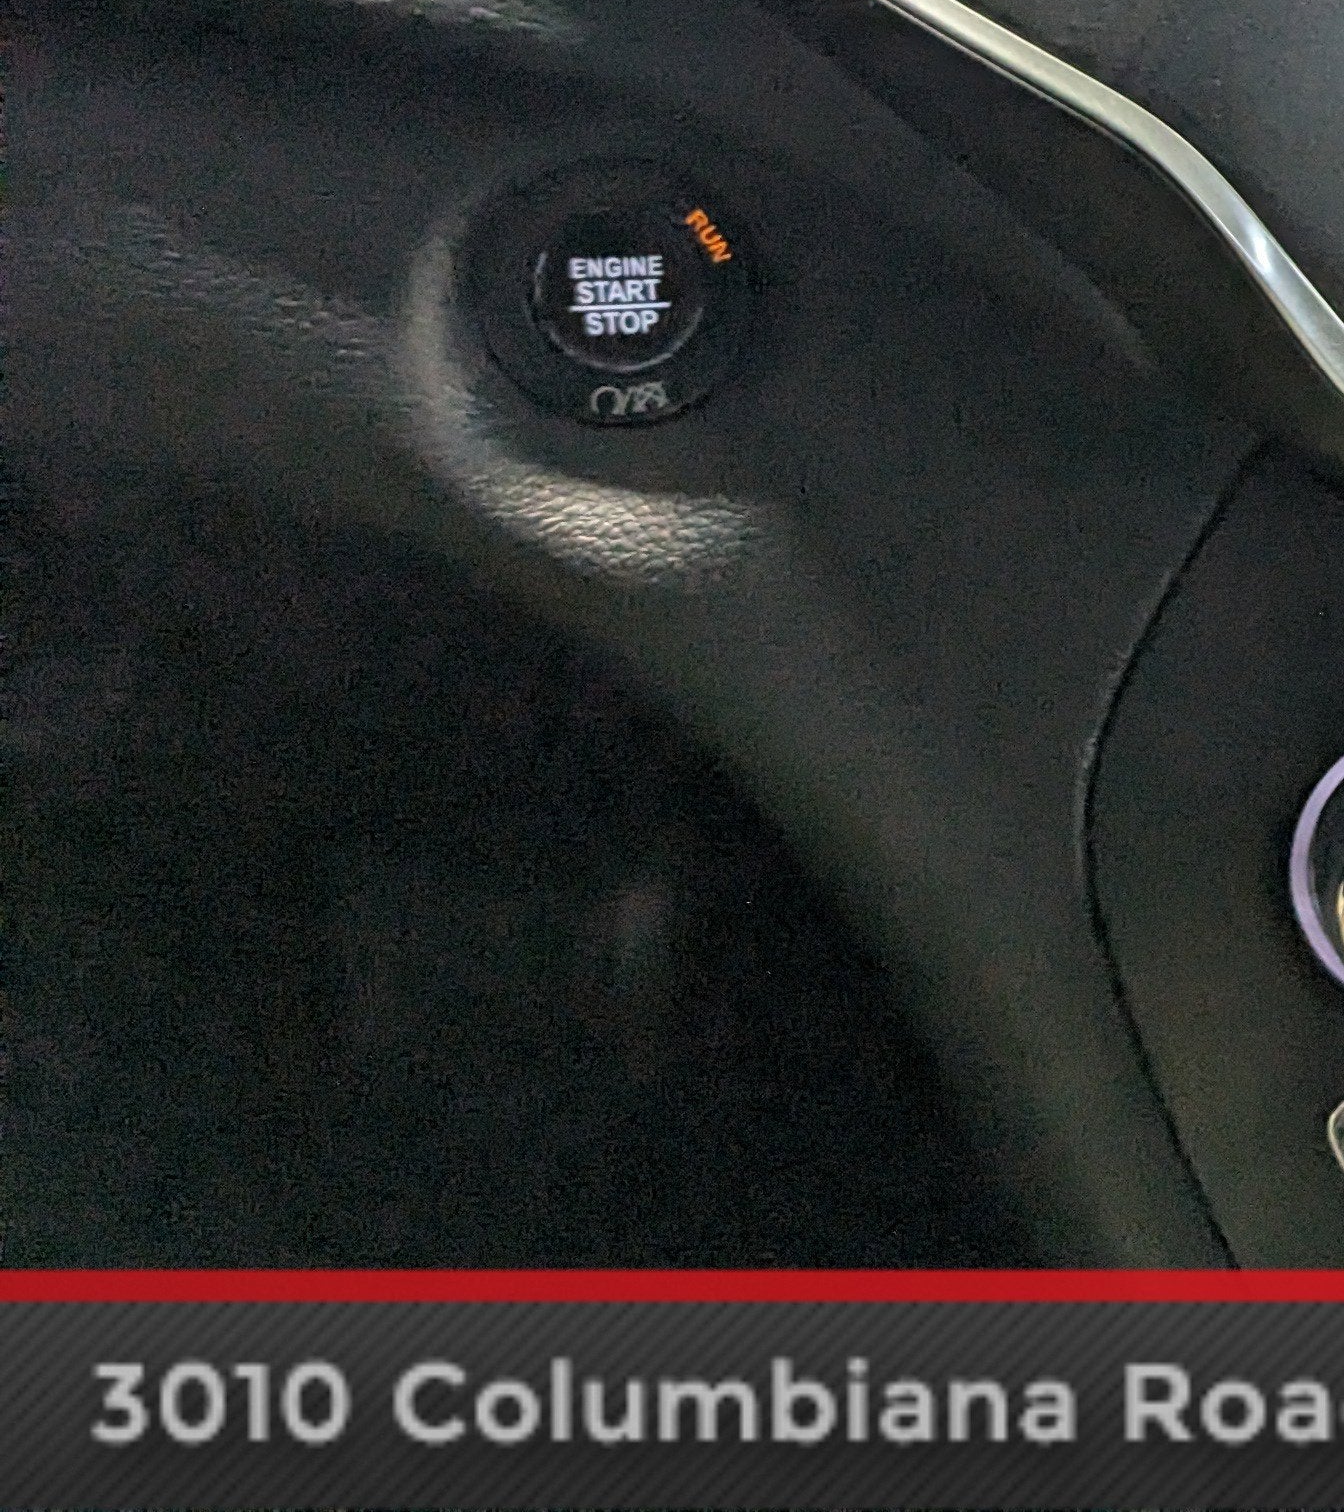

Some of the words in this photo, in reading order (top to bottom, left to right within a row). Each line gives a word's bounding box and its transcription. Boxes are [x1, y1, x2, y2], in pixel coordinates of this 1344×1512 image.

[684, 209, 733, 264] RUN
[568, 255, 665, 279] ENGINE
[576, 279, 662, 304] START
[585, 310, 660, 336] STOP
